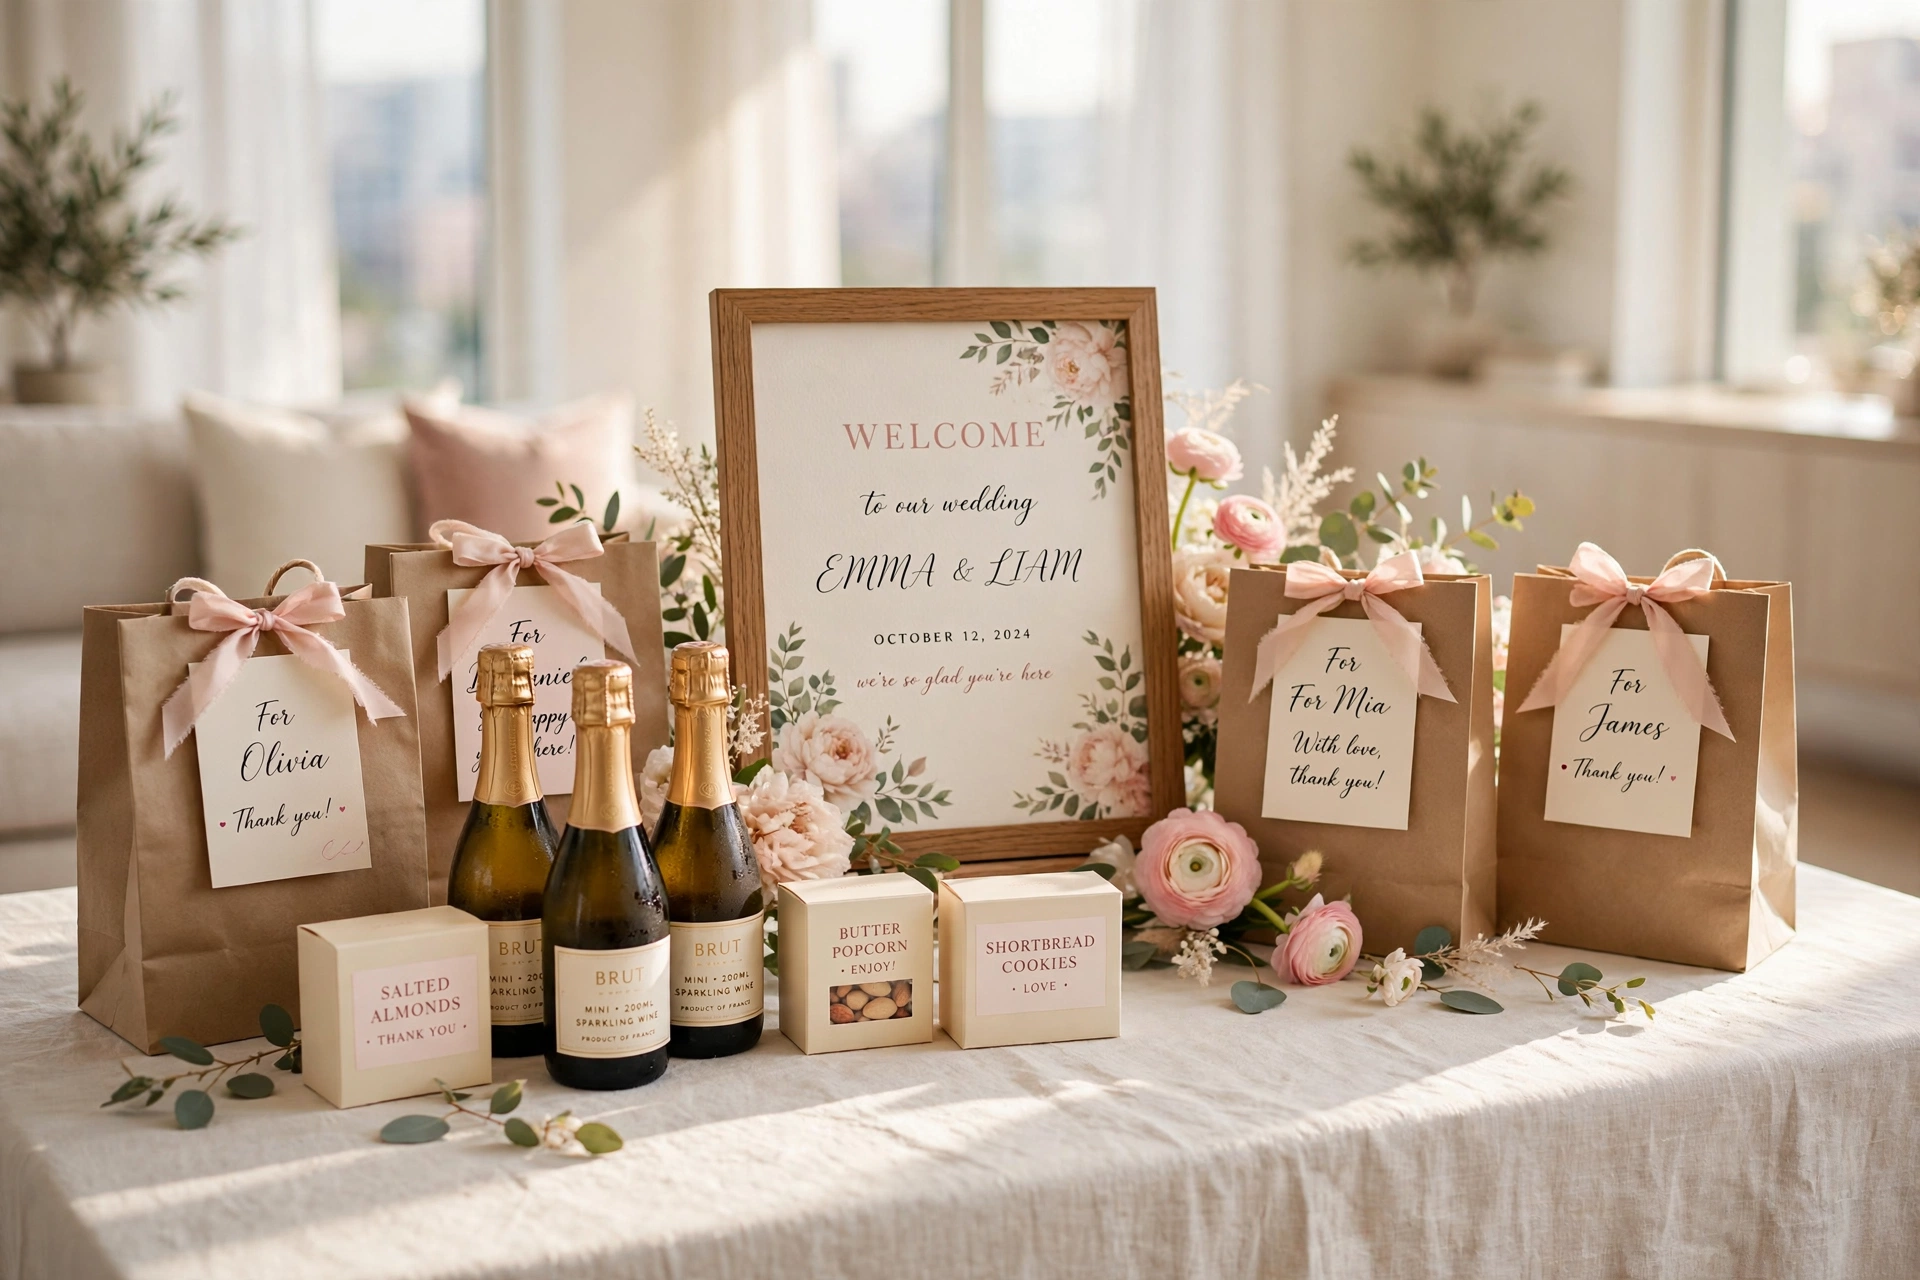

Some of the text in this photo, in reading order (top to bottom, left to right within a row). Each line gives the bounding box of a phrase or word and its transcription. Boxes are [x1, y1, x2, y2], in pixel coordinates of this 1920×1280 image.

[842, 421, 1046, 450] WELCOME
[859, 484, 1039, 527] to our wedding
[816, 548, 1083, 594] EMMA & LIAM
[509, 619, 546, 644] For
[874, 628, 1031, 646] OCTOBER 12, 2024
[1324, 646, 1362, 674] For
[856, 662, 1054, 696] we're so glad you're here
[1610, 668, 1647, 695] For
[1289, 683, 1391, 719] For Mia
[255, 699, 296, 732] For
[532, 712, 572, 735] appy
[1579, 703, 1670, 743] James
[533, 735, 575, 758] here!
[1292, 730, 1381, 760] With love,
[240, 740, 330, 782] Olivia
[1289, 764, 1385, 799] thank you!
[1573, 757, 1666, 793] Thank you!
[232, 797, 332, 837] Thank you!
[839, 922, 901, 941] BUTTER
[695, 938, 742, 957] BRUT
[832, 940, 908, 959] POPCORN
[985, 934, 1096, 955] SHORTBREAD
[595, 966, 645, 986] BRUT
[851, 961, 896, 975] ENJOY!
[1002, 955, 1078, 974] COOKIES
[381, 976, 450, 1001] SALTED
[674, 981, 754, 997] SPARKLING WINE
[684, 971, 750, 984] MINI 200ML
[1023, 981, 1057, 994] LOVE
[490, 986, 537, 996] ARKLING
[370, 996, 461, 1024] ALMONDS
[585, 1000, 654, 1014] MINI 200ML
[576, 1010, 658, 1028] SPARKLING WINE
[377, 1023, 456, 1046] THANK YOU
[581, 1035, 616, 1043] PRODUCT
